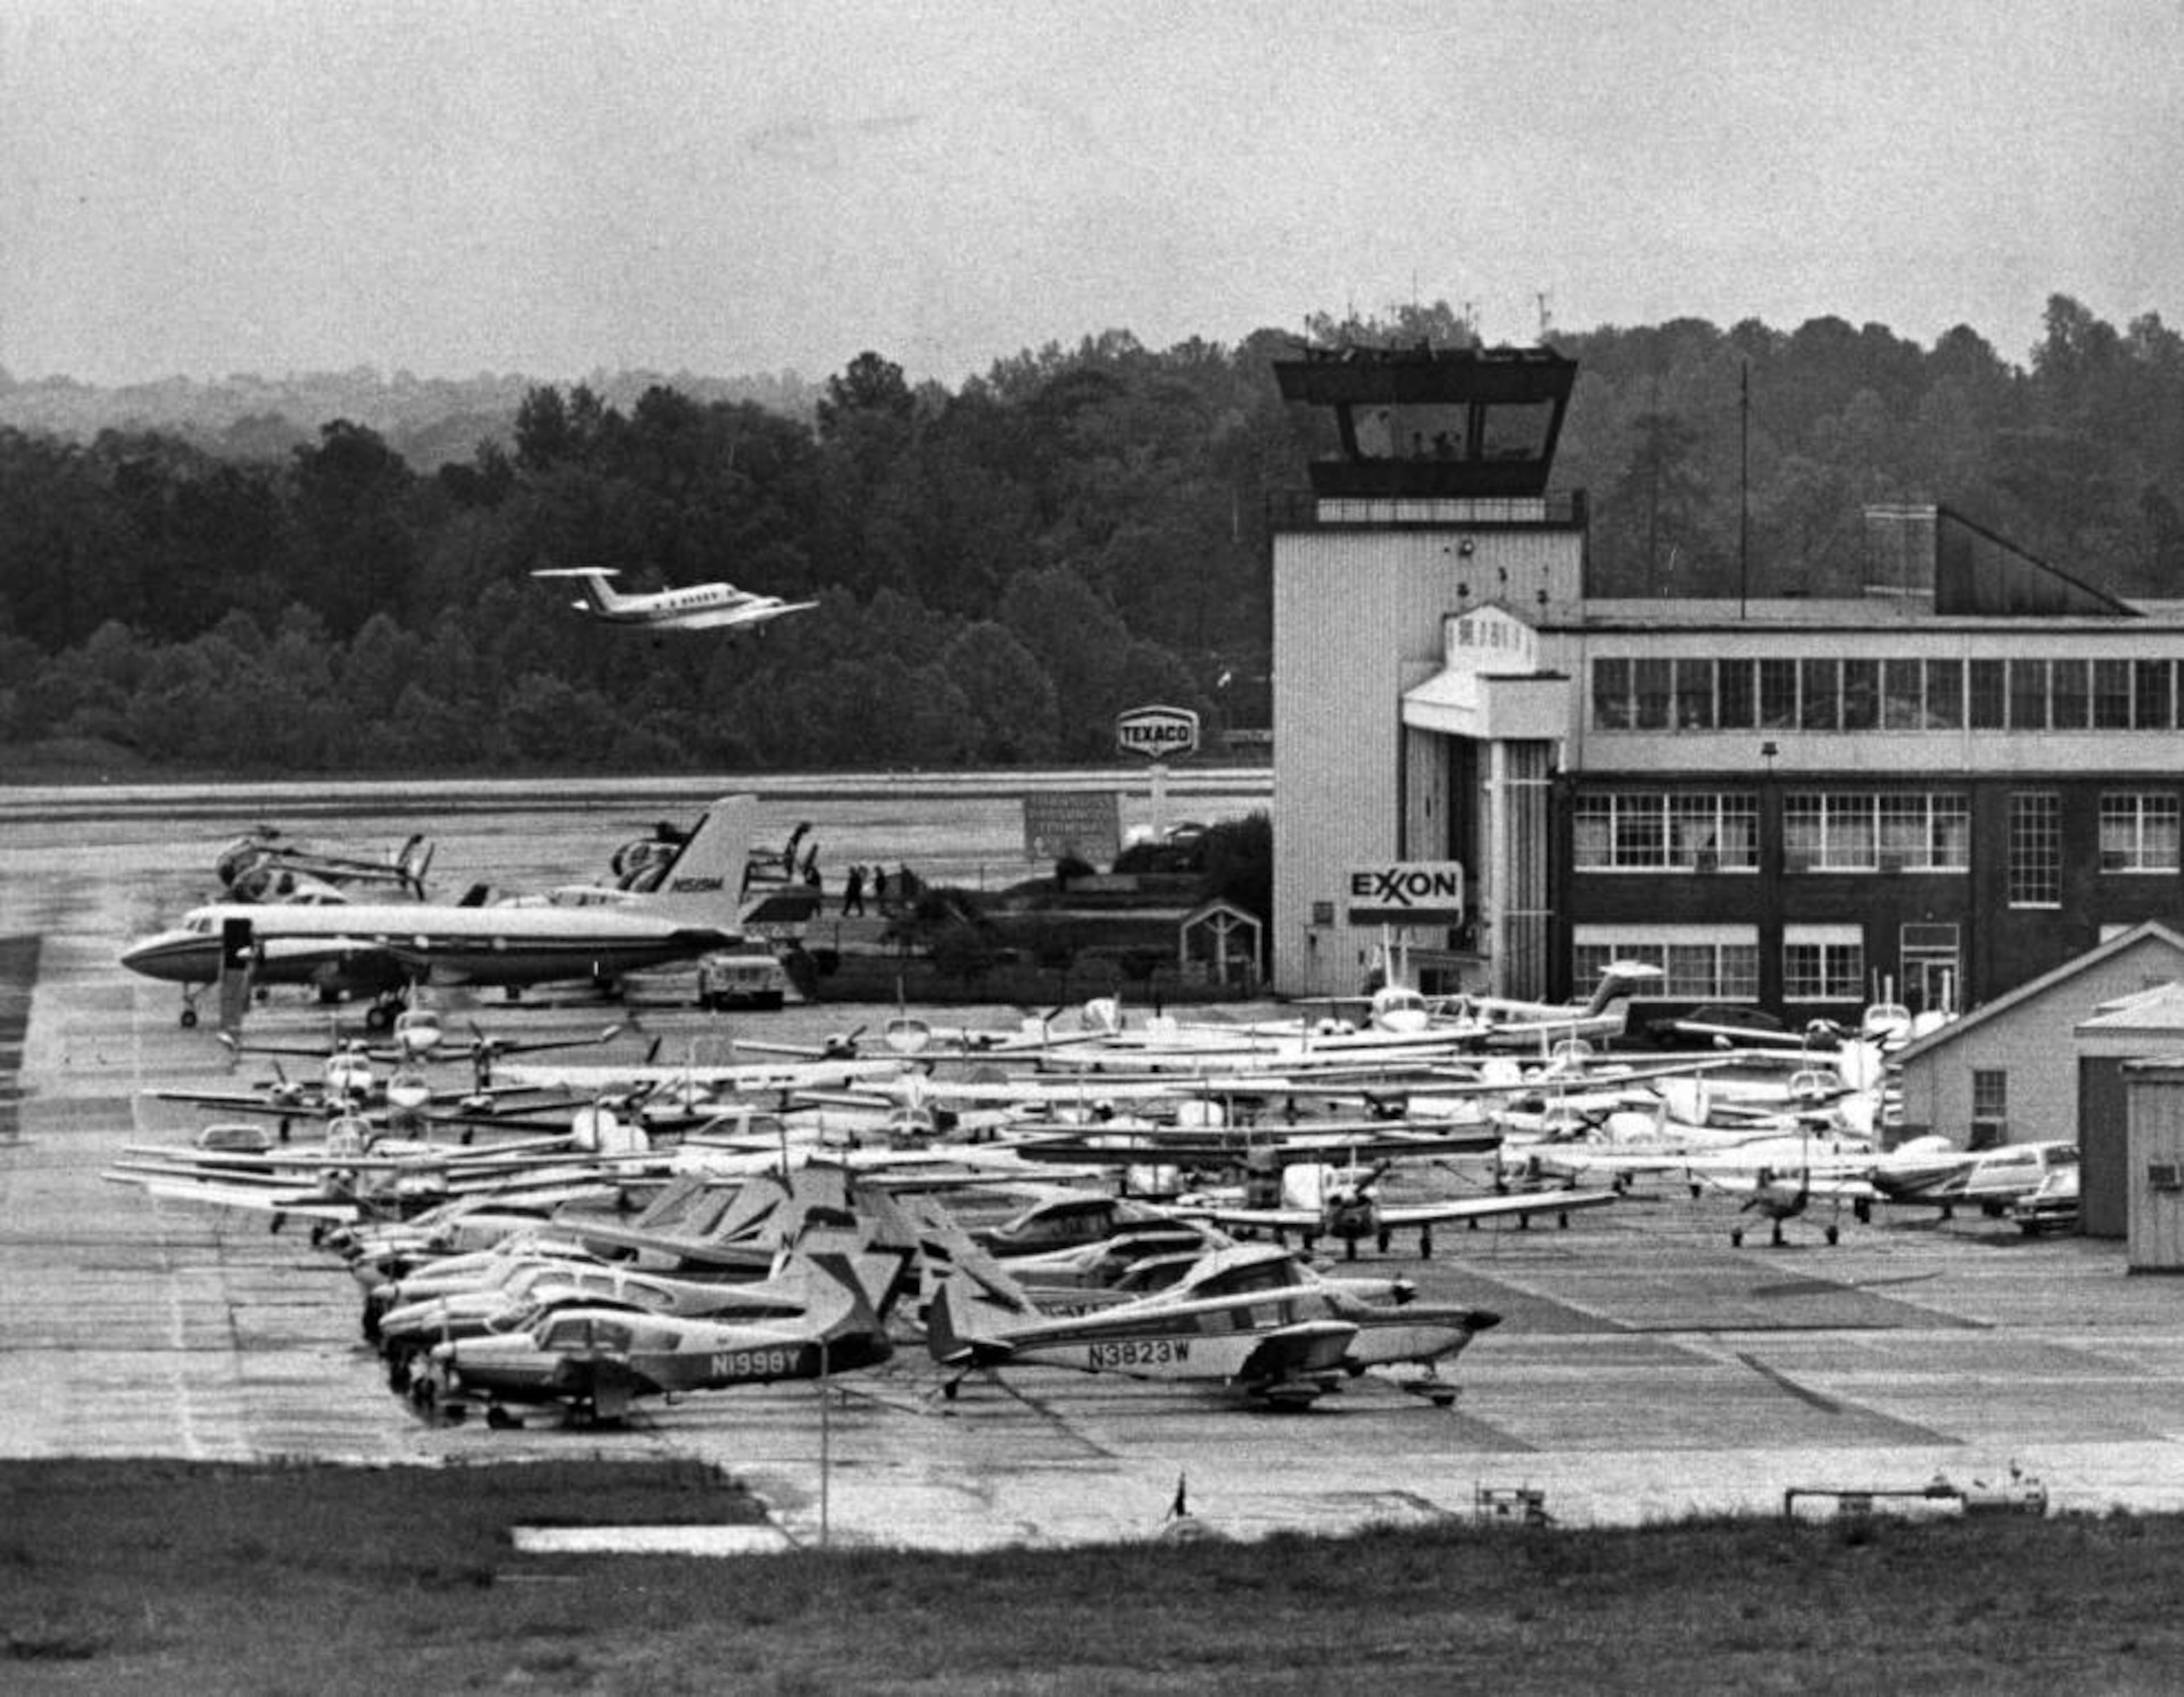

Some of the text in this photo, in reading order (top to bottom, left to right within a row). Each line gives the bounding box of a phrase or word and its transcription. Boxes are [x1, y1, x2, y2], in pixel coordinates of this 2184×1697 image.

[1123, 726, 1188, 741] TEXACO
[1351, 868, 1456, 906] EXXON
[712, 1349, 800, 1377] N1998Y
[1089, 1338, 1190, 1369] N3823W
